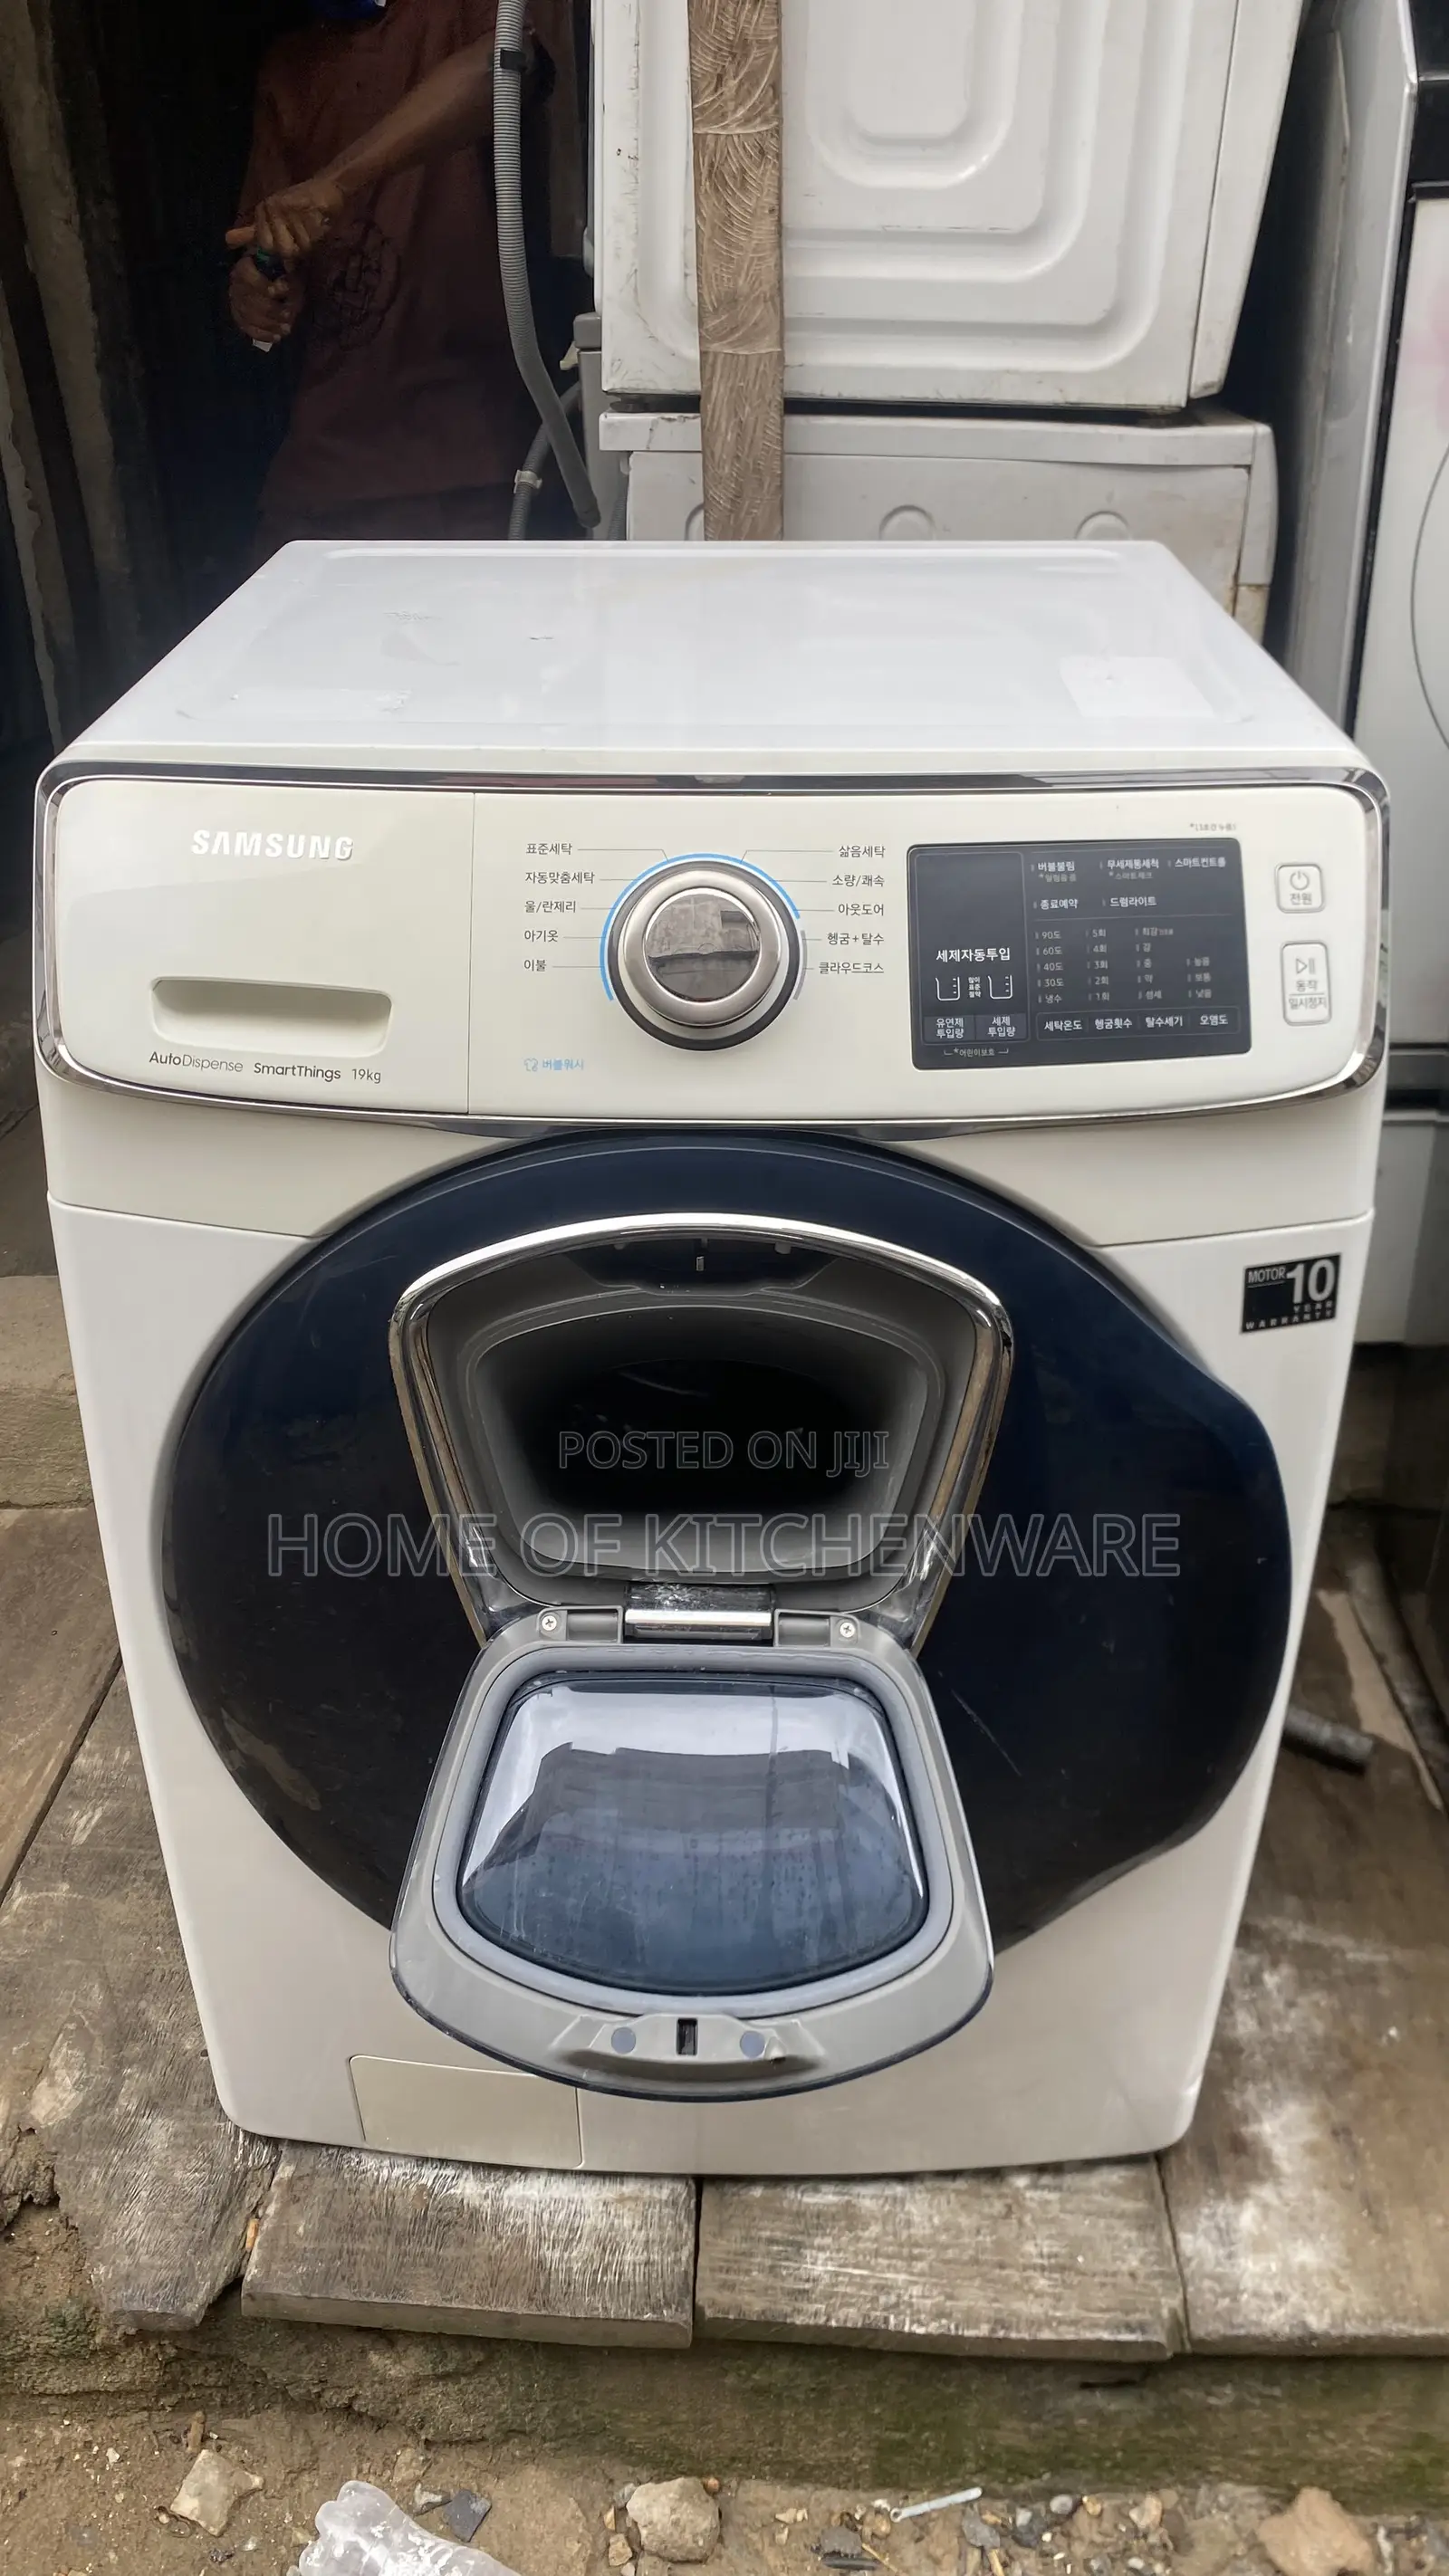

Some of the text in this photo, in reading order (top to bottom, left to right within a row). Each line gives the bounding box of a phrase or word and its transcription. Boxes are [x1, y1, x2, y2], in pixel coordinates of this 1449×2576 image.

[191, 829, 354, 861] SAMSUNG
[525, 842, 573, 856] 표준세탁
[838, 845, 886, 858] 삶음세탁
[524, 870, 596, 885] 자동맞춤세탁
[831, 874, 885, 887] 소량/쾌속
[1041, 898, 1078, 910] 종료예약
[1109, 896, 1157, 907] 드럼라이트
[1290, 893, 1312, 905] 전원
[524, 900, 577, 914] 울/란제리
[838, 904, 885, 916] 아웃도어
[523, 929, 559, 943] 아기옷
[1041, 931, 1061, 939] 90도
[936, 947, 1011, 962] 세제자동투입
[1042, 947, 1062, 955] 60도
[523, 959, 547, 972] 이불
[819, 962, 885, 974] 클라우드코스
[1043, 962, 1063, 972] 40도
[1044, 979, 1064, 988] 30도
[1296, 980, 1318, 992] 동작
[1288, 997, 1328, 1010] 일시정지
[936, 1018, 964, 1028] 유연제
[992, 1016, 1011, 1026] 세제
[1044, 1020, 1082, 1032] 세탁온도
[1094, 1018, 1133, 1030] 헹굼횟수
[1145, 1015, 1184, 1029] 탈수세기
[1200, 1014, 1229, 1026] 오염도
[936, 1029, 964, 1039] 투입량
[988, 1026, 1016, 1038] 투입량
[254, 1062, 341, 1083] SmartThings
[351, 1068, 382, 1084] 19kg
[1248, 1258, 1336, 1304] MOTOR 10
[1245, 1309, 1332, 1330] WARRANTY
